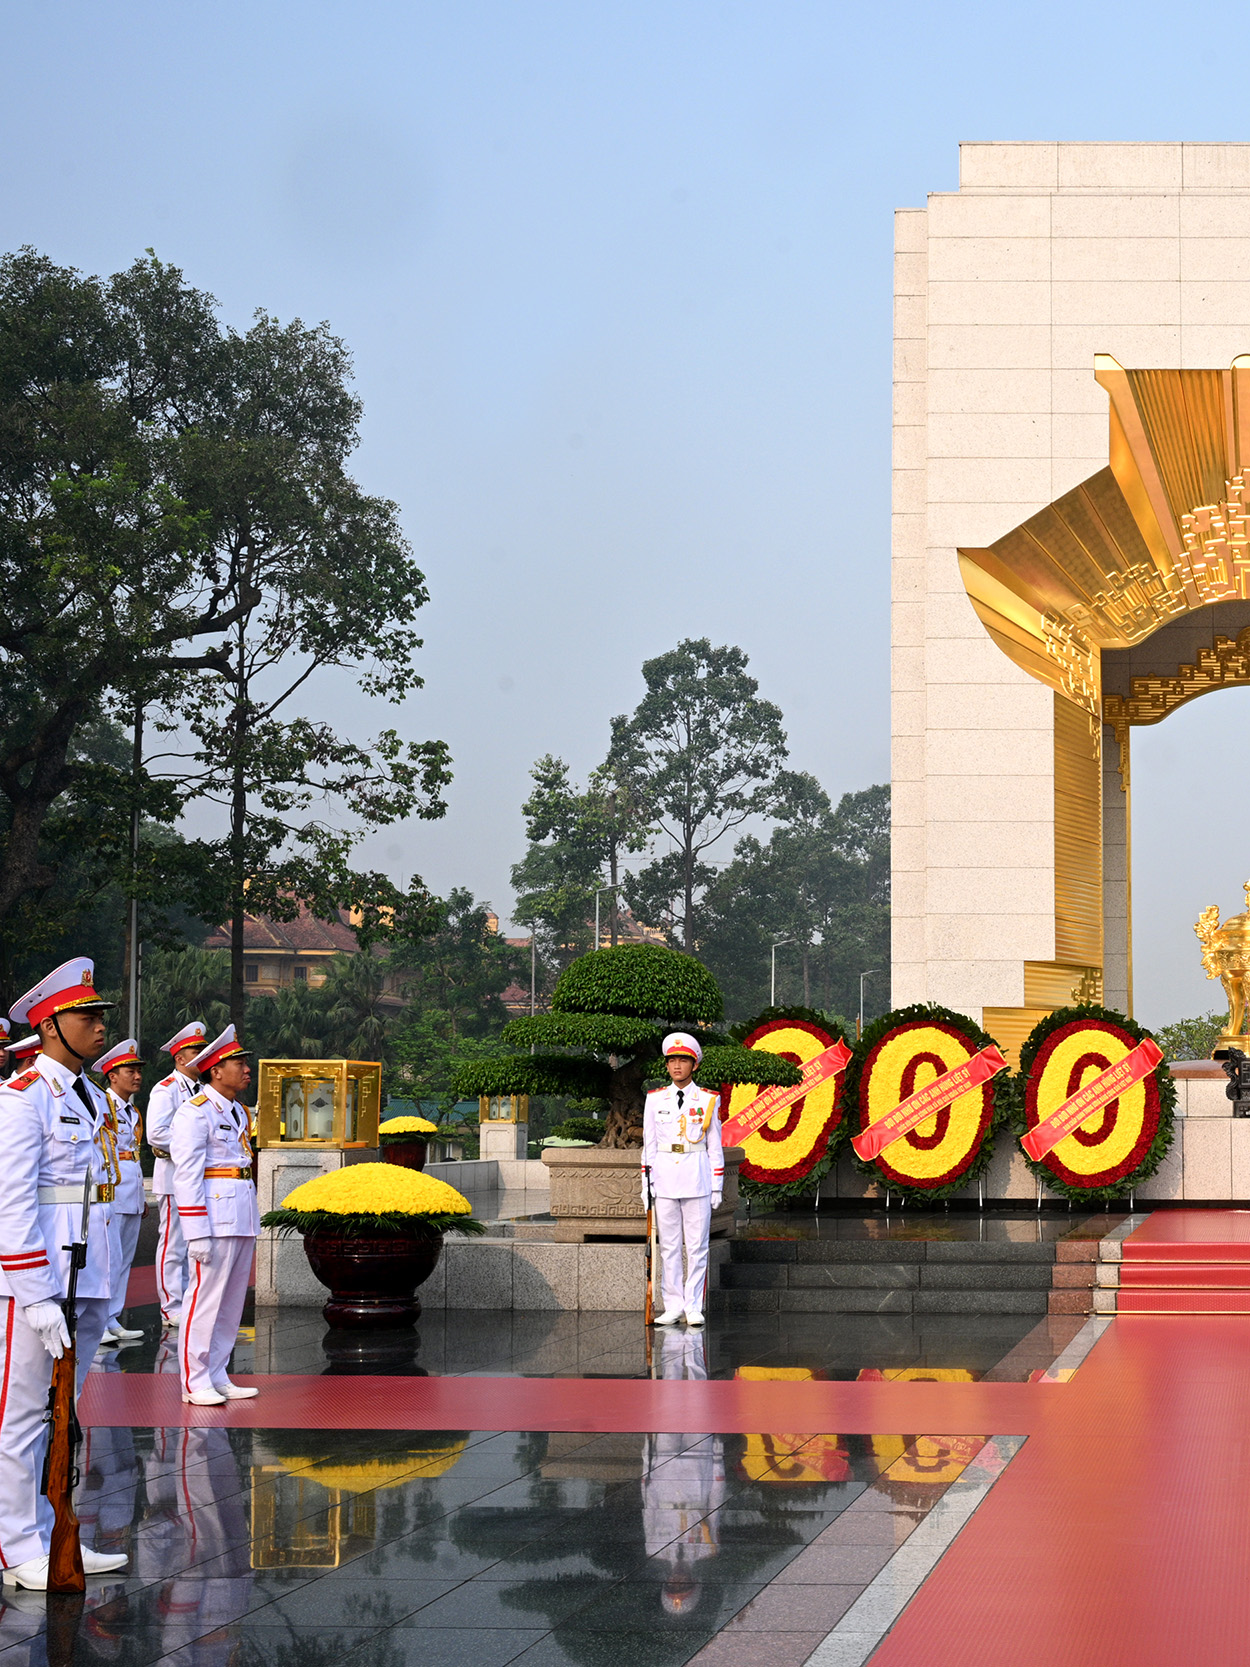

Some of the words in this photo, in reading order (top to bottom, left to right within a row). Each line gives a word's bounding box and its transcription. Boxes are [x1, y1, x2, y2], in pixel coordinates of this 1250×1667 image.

[769, 1088, 782, 1100] CÁC
[802, 1065, 816, 1077] LIỆT
[918, 1092, 931, 1104] CÁC
[951, 1072, 964, 1083] LIỆT
[1082, 1089, 1095, 1102] CÁC
[1112, 1067, 1125, 1079] LIỆT
